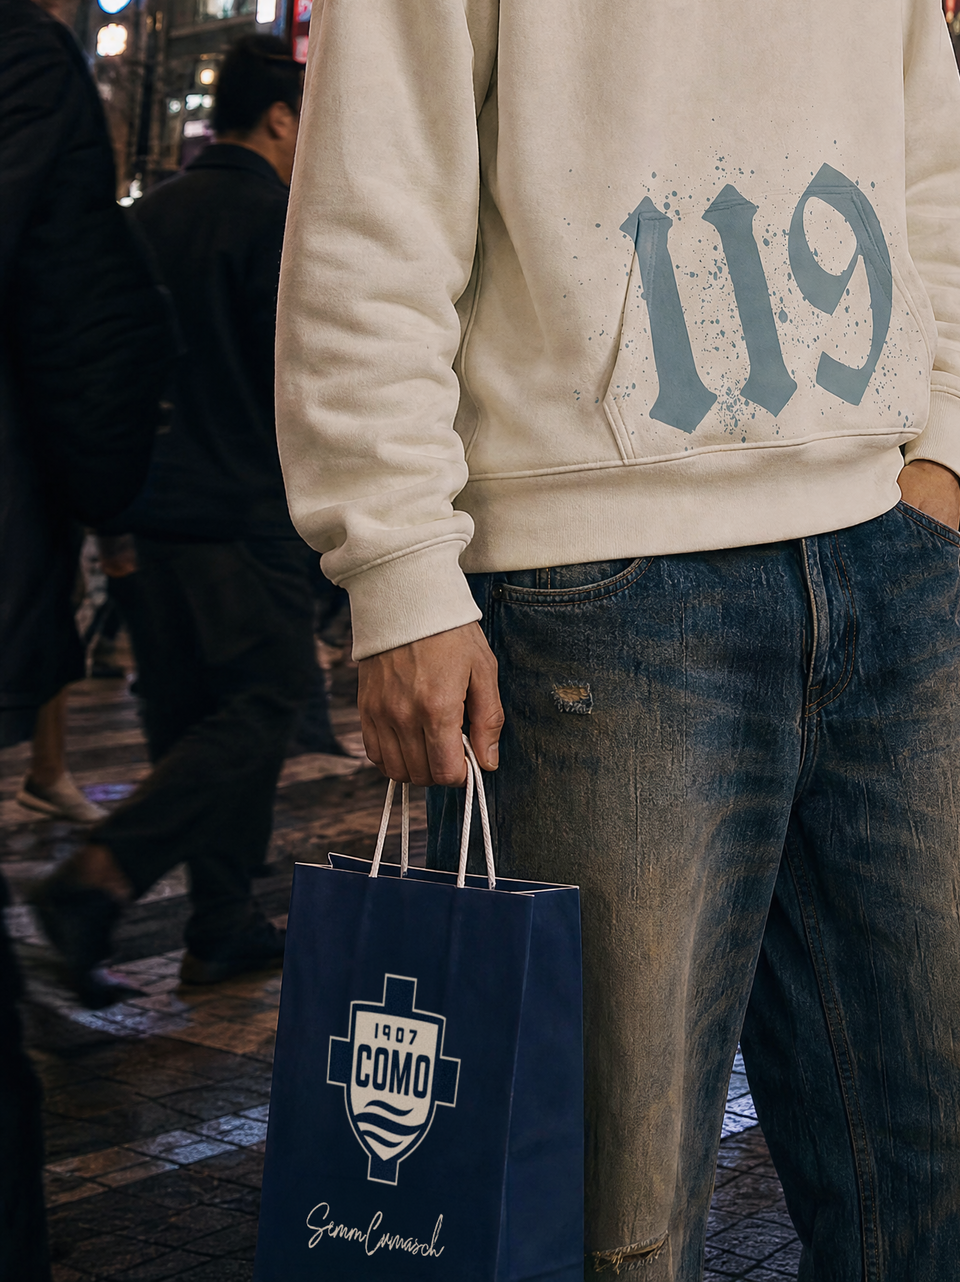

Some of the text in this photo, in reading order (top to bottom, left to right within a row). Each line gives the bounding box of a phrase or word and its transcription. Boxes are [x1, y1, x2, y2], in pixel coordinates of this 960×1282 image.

[619, 162, 893, 434] 119
[374, 1022, 418, 1046] 1907
[355, 1043, 432, 1100] COMO
